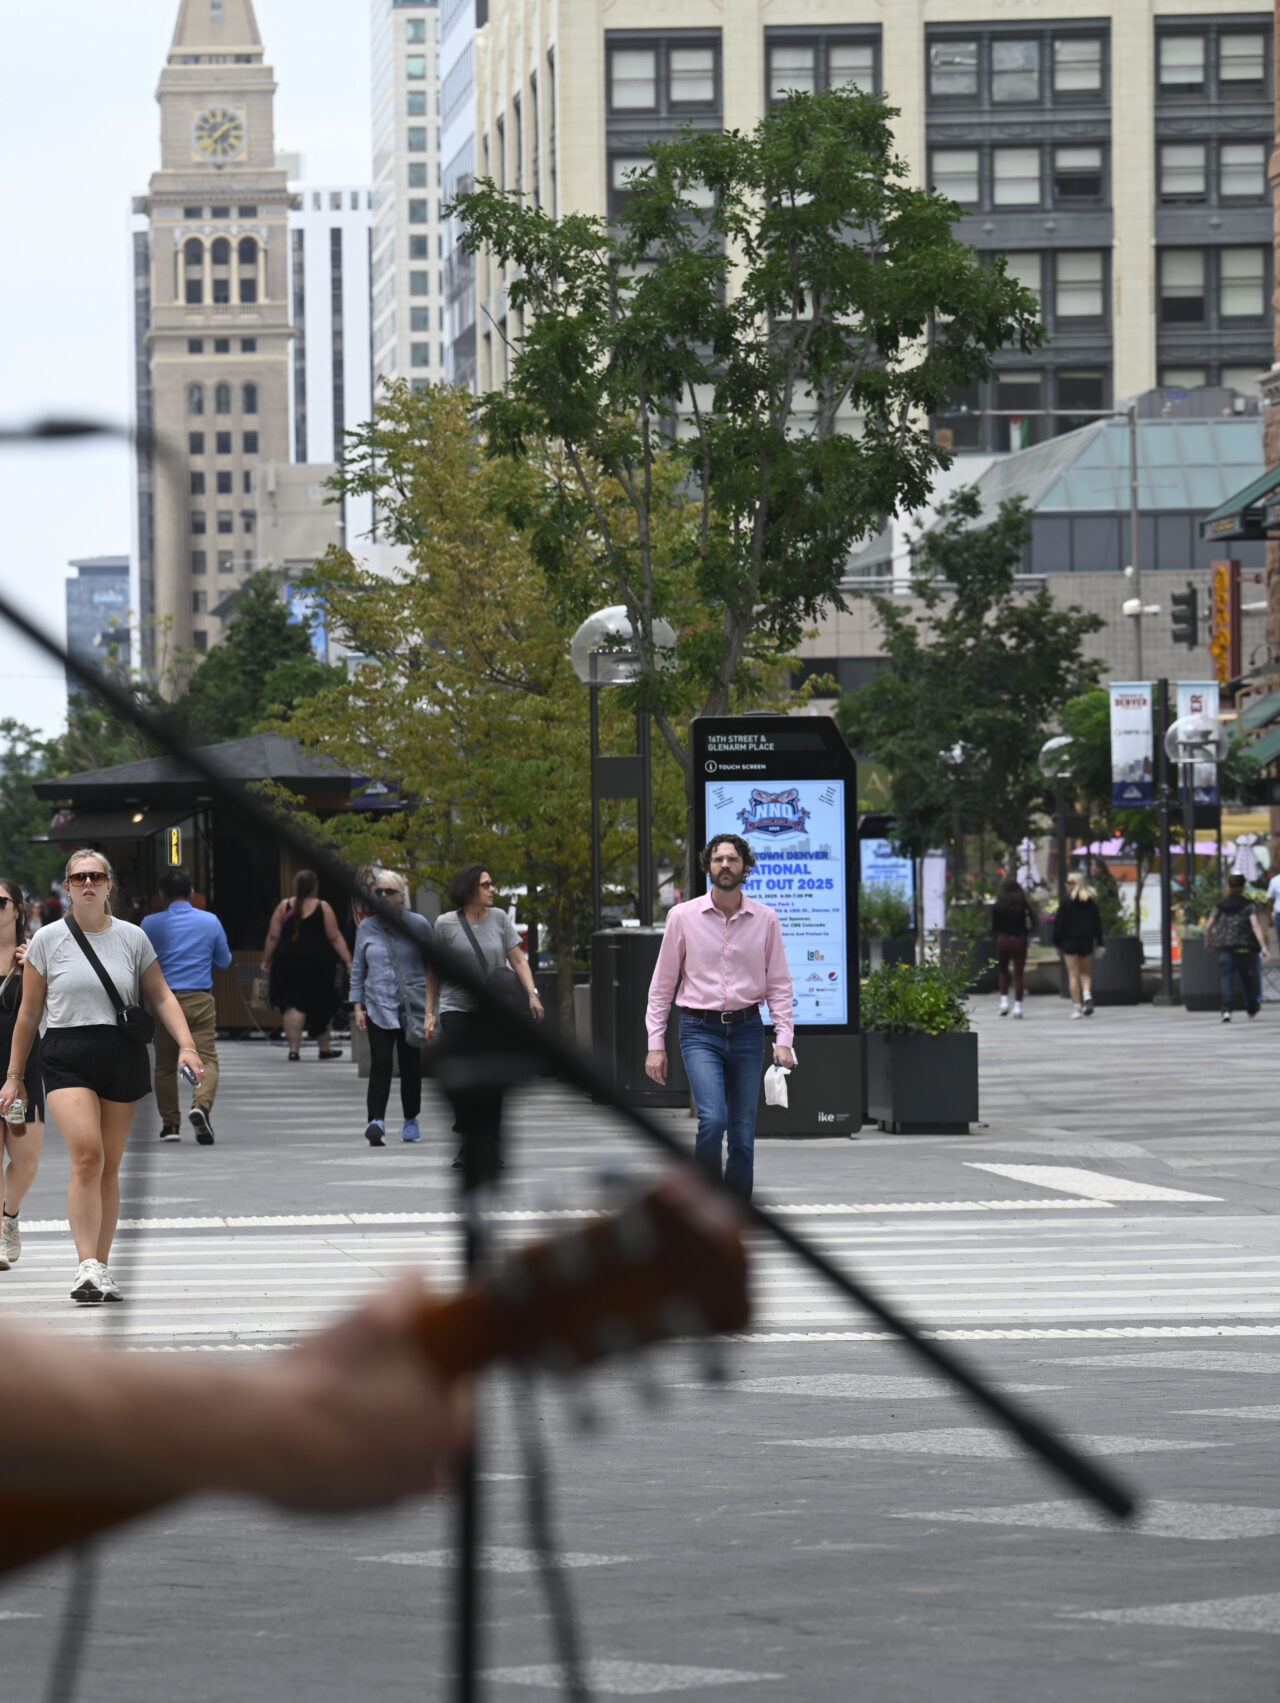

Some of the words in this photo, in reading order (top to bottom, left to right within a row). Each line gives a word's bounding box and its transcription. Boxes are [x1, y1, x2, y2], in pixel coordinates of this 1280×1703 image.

[707, 735, 727, 743] 16TH
[728, 735, 758, 743] STREET
[759, 735, 767, 743] &
[707, 743, 747, 751] GLENARM
[748, 743, 775, 751] PLACE
[754, 851, 785, 860] TOWN
[786, 851, 829, 860] DENVER
[751, 863, 812, 875] ATIONAL
[765, 878, 794, 890] OUT
[797, 878, 834, 890] 2025
[817, 1111, 835, 1122] ike
